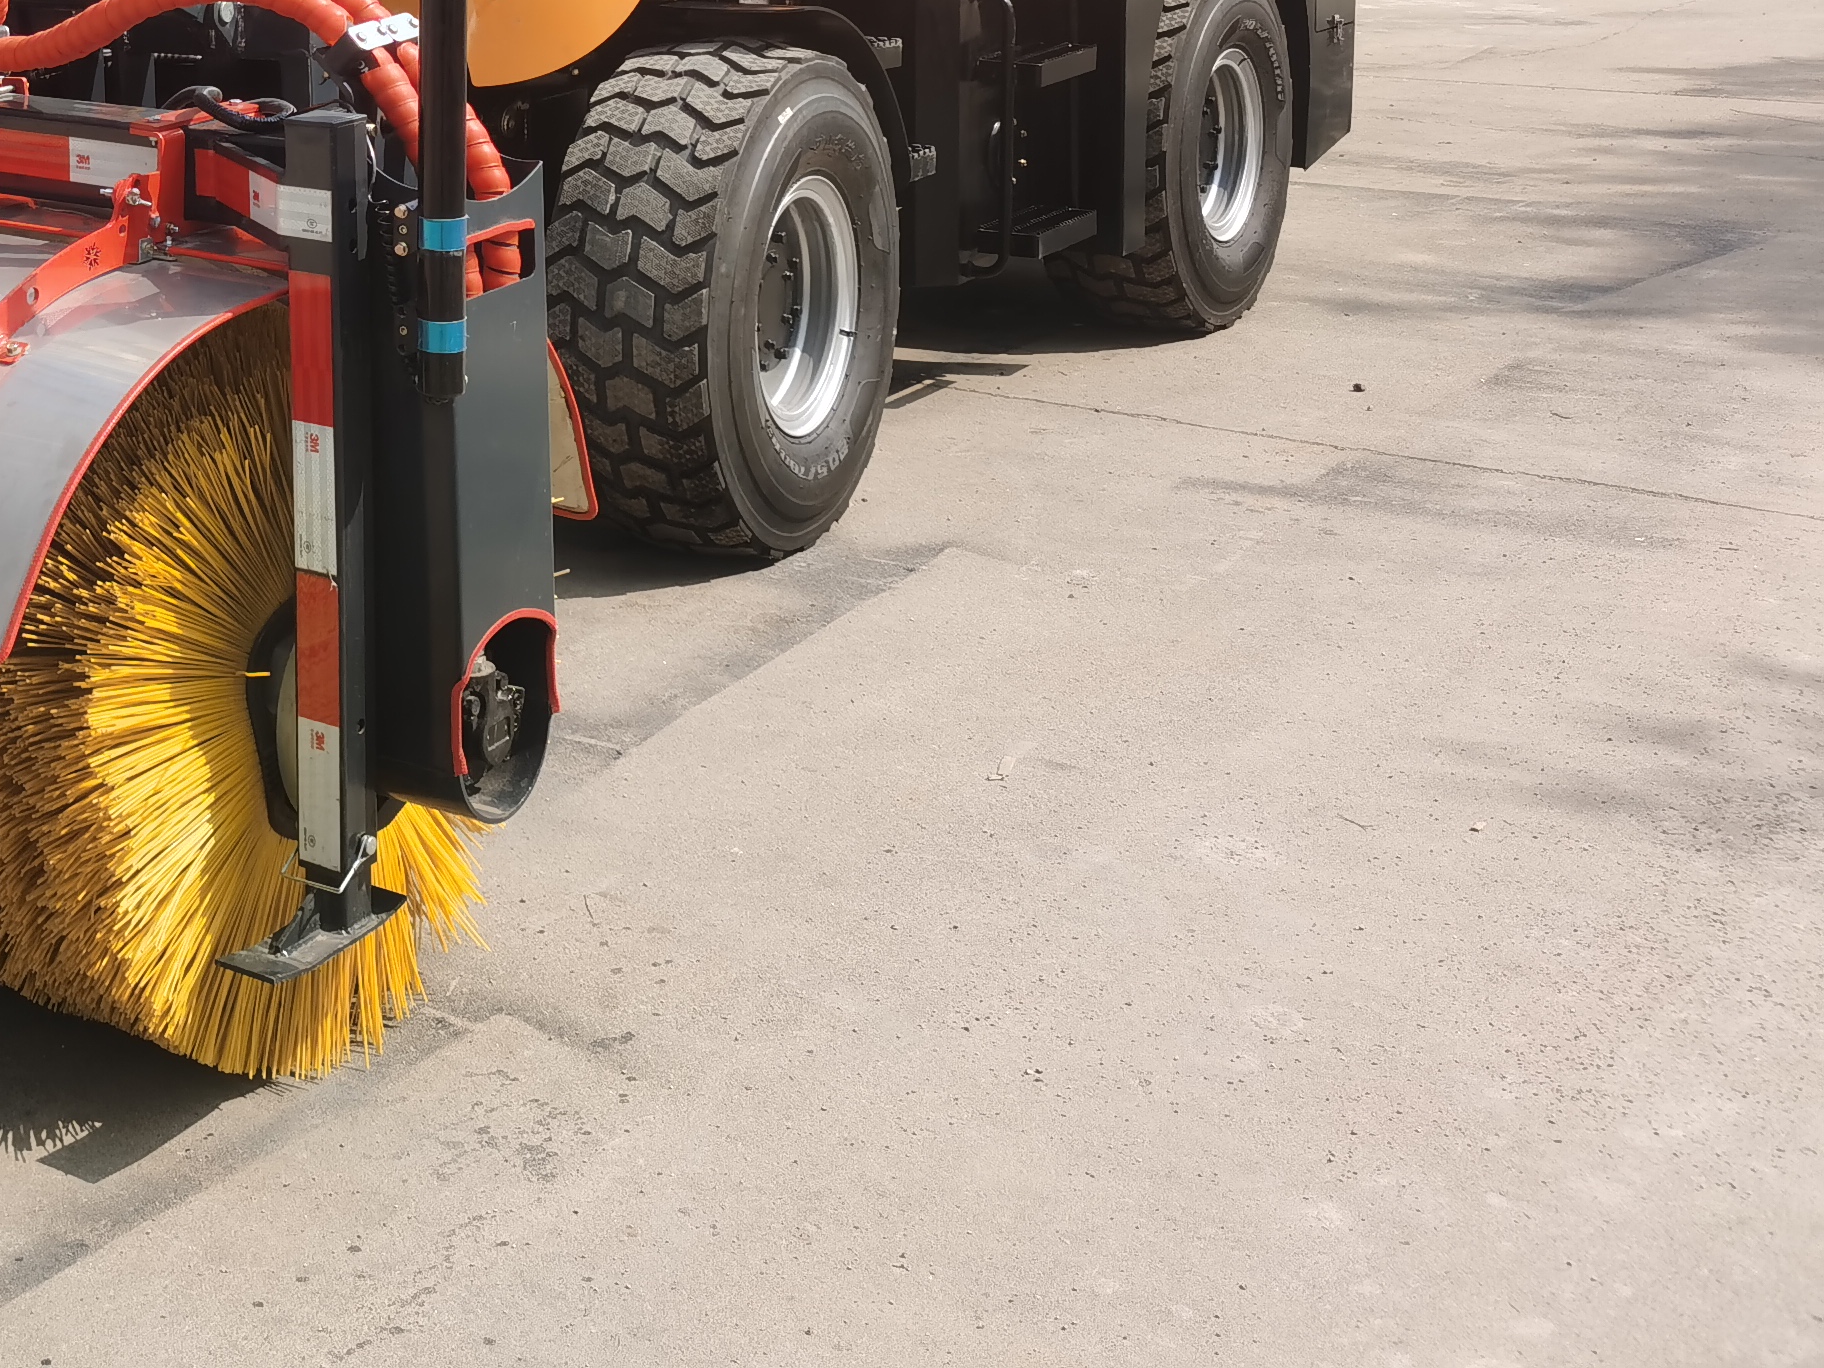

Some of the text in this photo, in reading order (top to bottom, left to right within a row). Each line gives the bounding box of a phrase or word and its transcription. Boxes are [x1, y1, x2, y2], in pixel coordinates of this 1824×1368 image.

[76, 153, 90, 165] 3M
[309, 433, 320, 454] 3M
[315, 730, 325, 751] 3M
